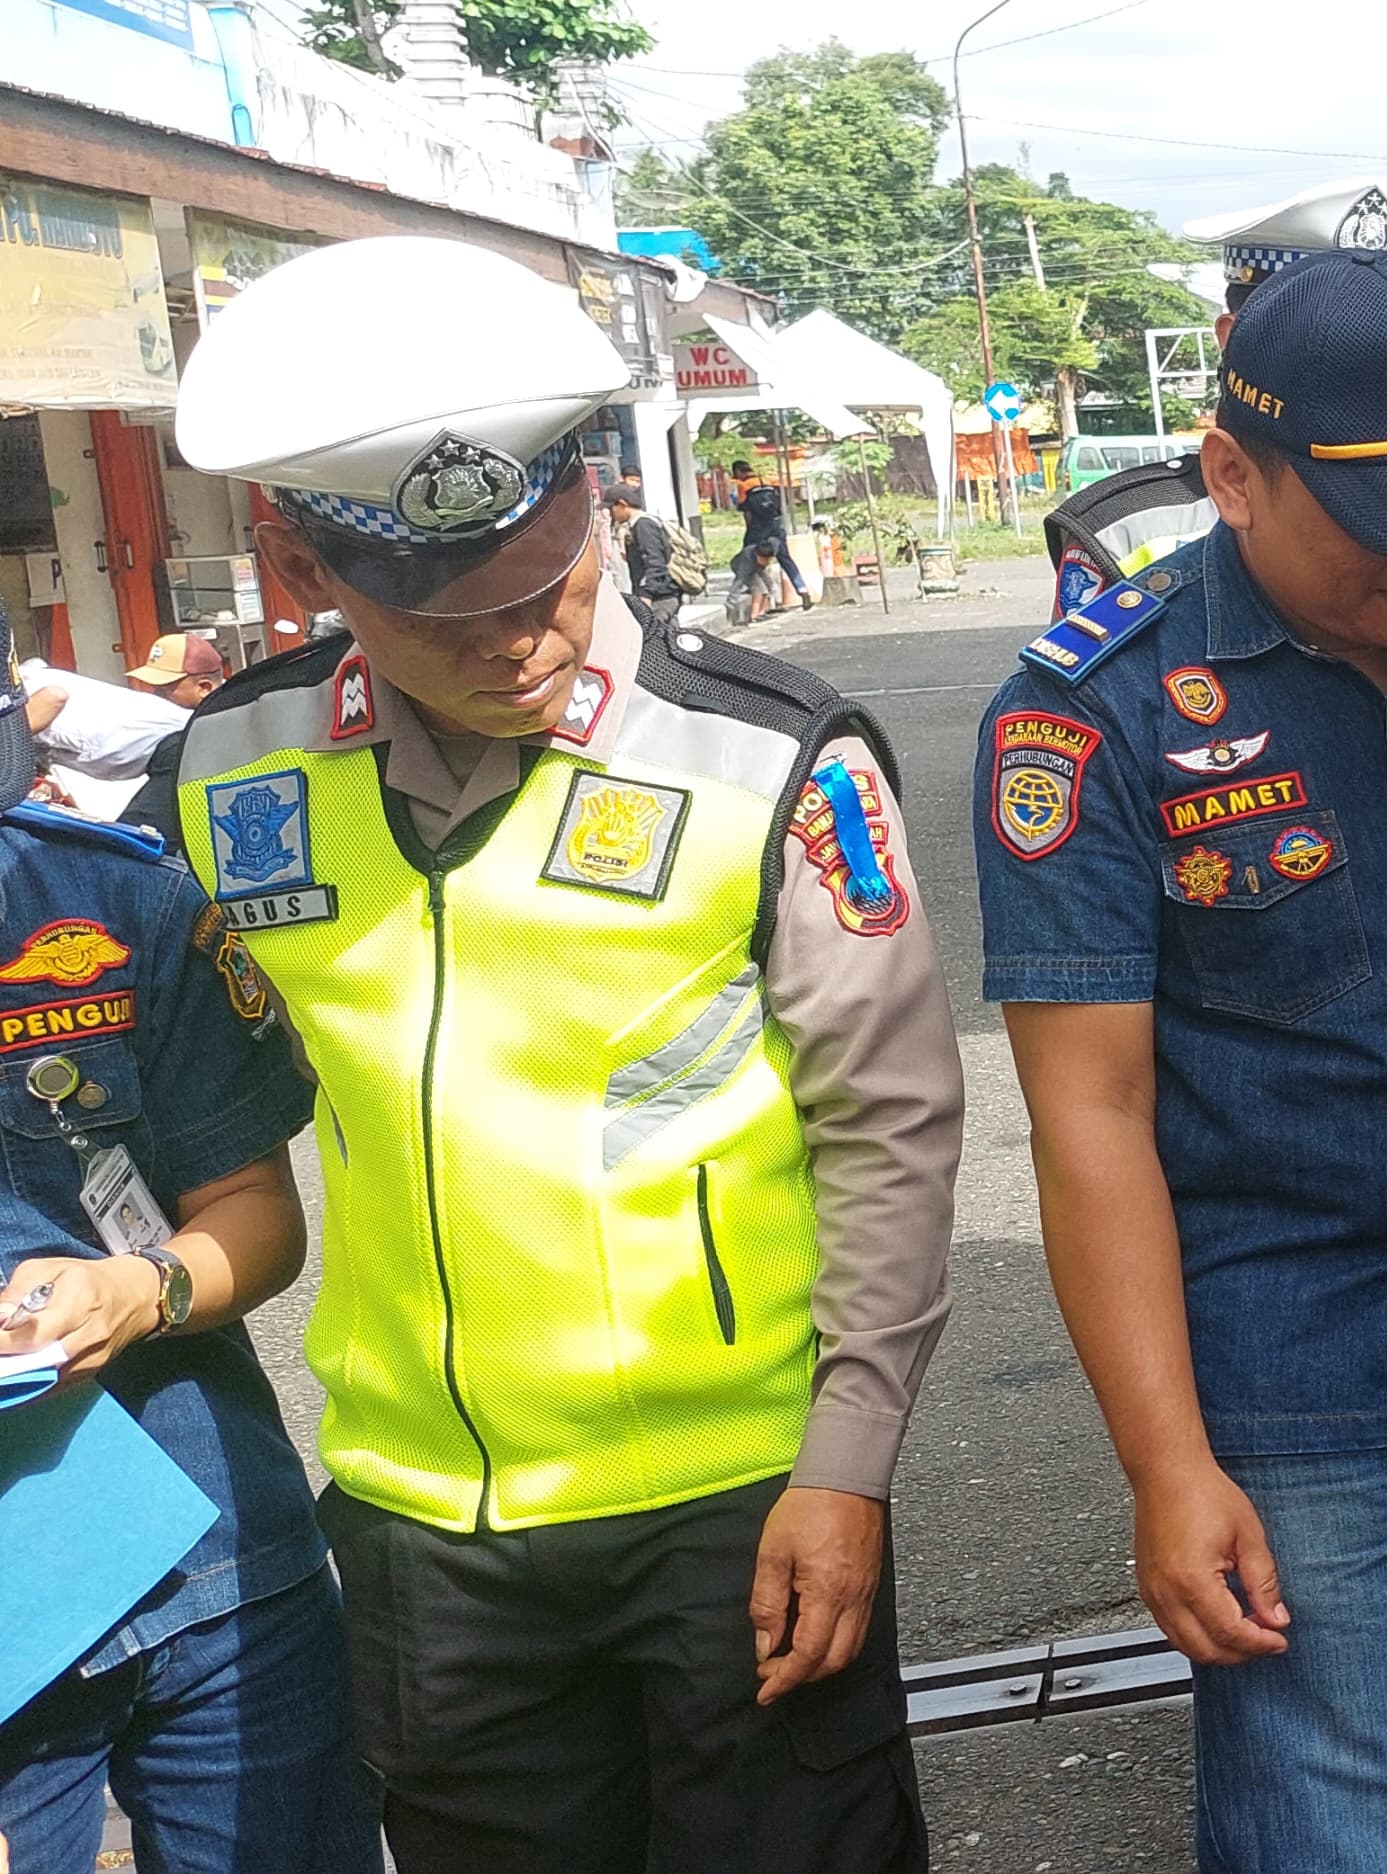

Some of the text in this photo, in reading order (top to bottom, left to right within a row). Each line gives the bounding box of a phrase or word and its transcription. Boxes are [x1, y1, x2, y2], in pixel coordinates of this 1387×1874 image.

[690, 346, 730, 366] WC
[677, 368, 747, 387] UMUM
[1227, 367, 1285, 419] MAMET
[1004, 720, 1088, 748] PENGUJI
[1002, 749, 1076, 777] PERHUBUNGAN
[1174, 780, 1293, 830] MAMET
[584, 852, 628, 867] POLISI
[226, 896, 302, 926] AGUS
[2, 998, 130, 1043] PENGUJI
